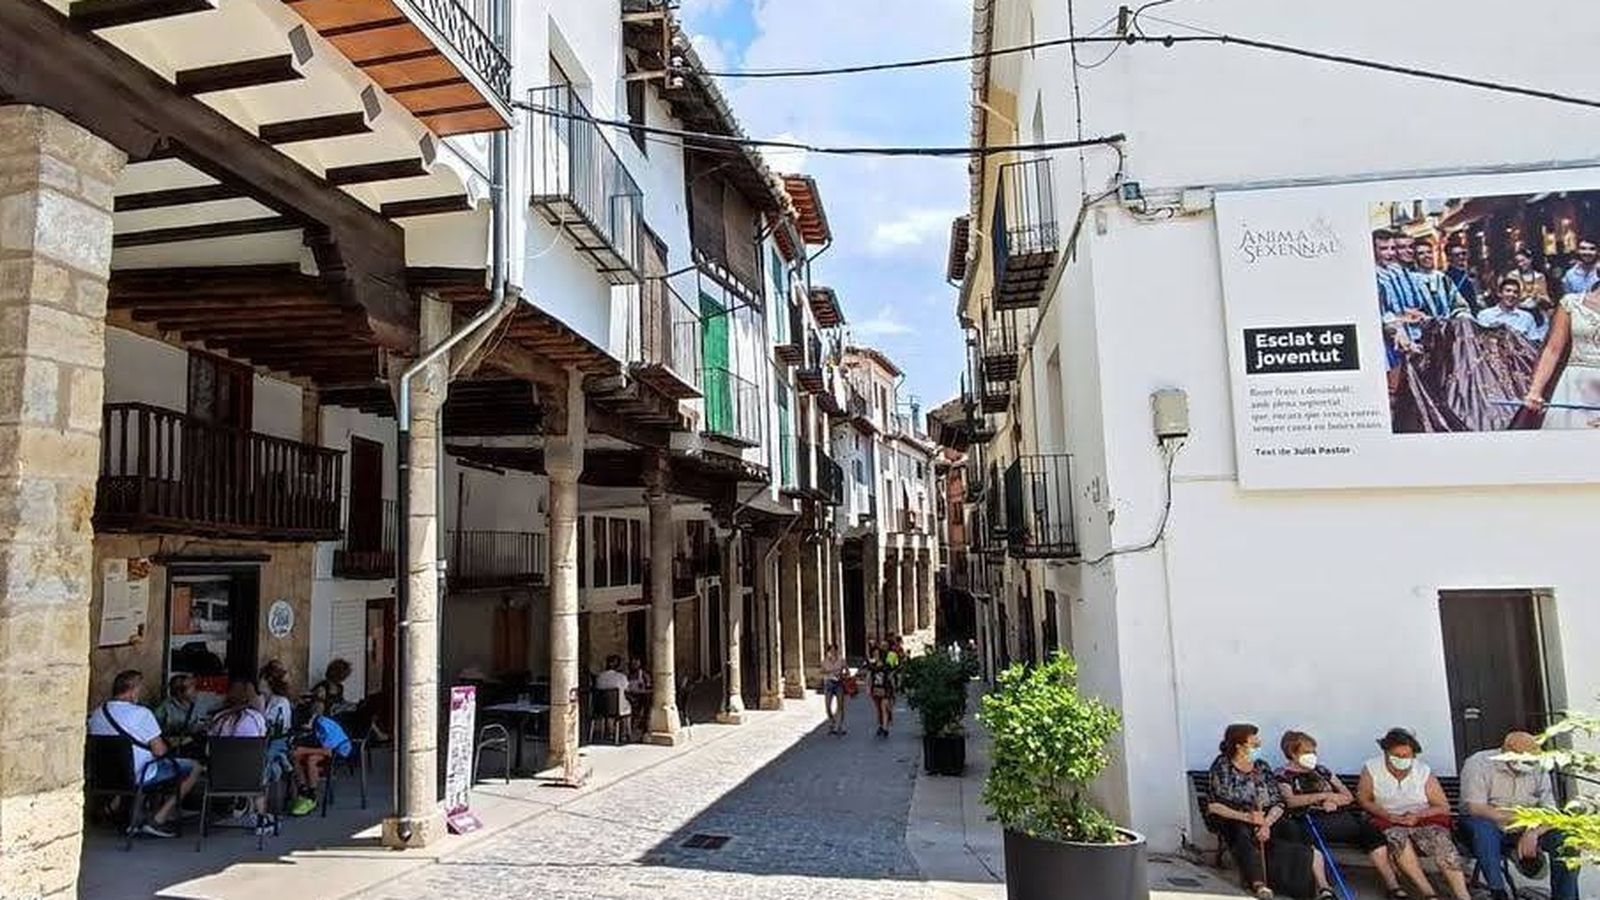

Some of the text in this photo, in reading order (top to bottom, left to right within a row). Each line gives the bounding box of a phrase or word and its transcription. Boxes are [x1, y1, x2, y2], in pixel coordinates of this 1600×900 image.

[1244, 241, 1338, 263] SEXENNAL
[1256, 330, 1344, 348] Esclat de
[1256, 348, 1341, 369] joventut
[1255, 448, 1276, 456] Text
[1278, 447, 1291, 455] de
[1318, 446, 1350, 455] Pastor
